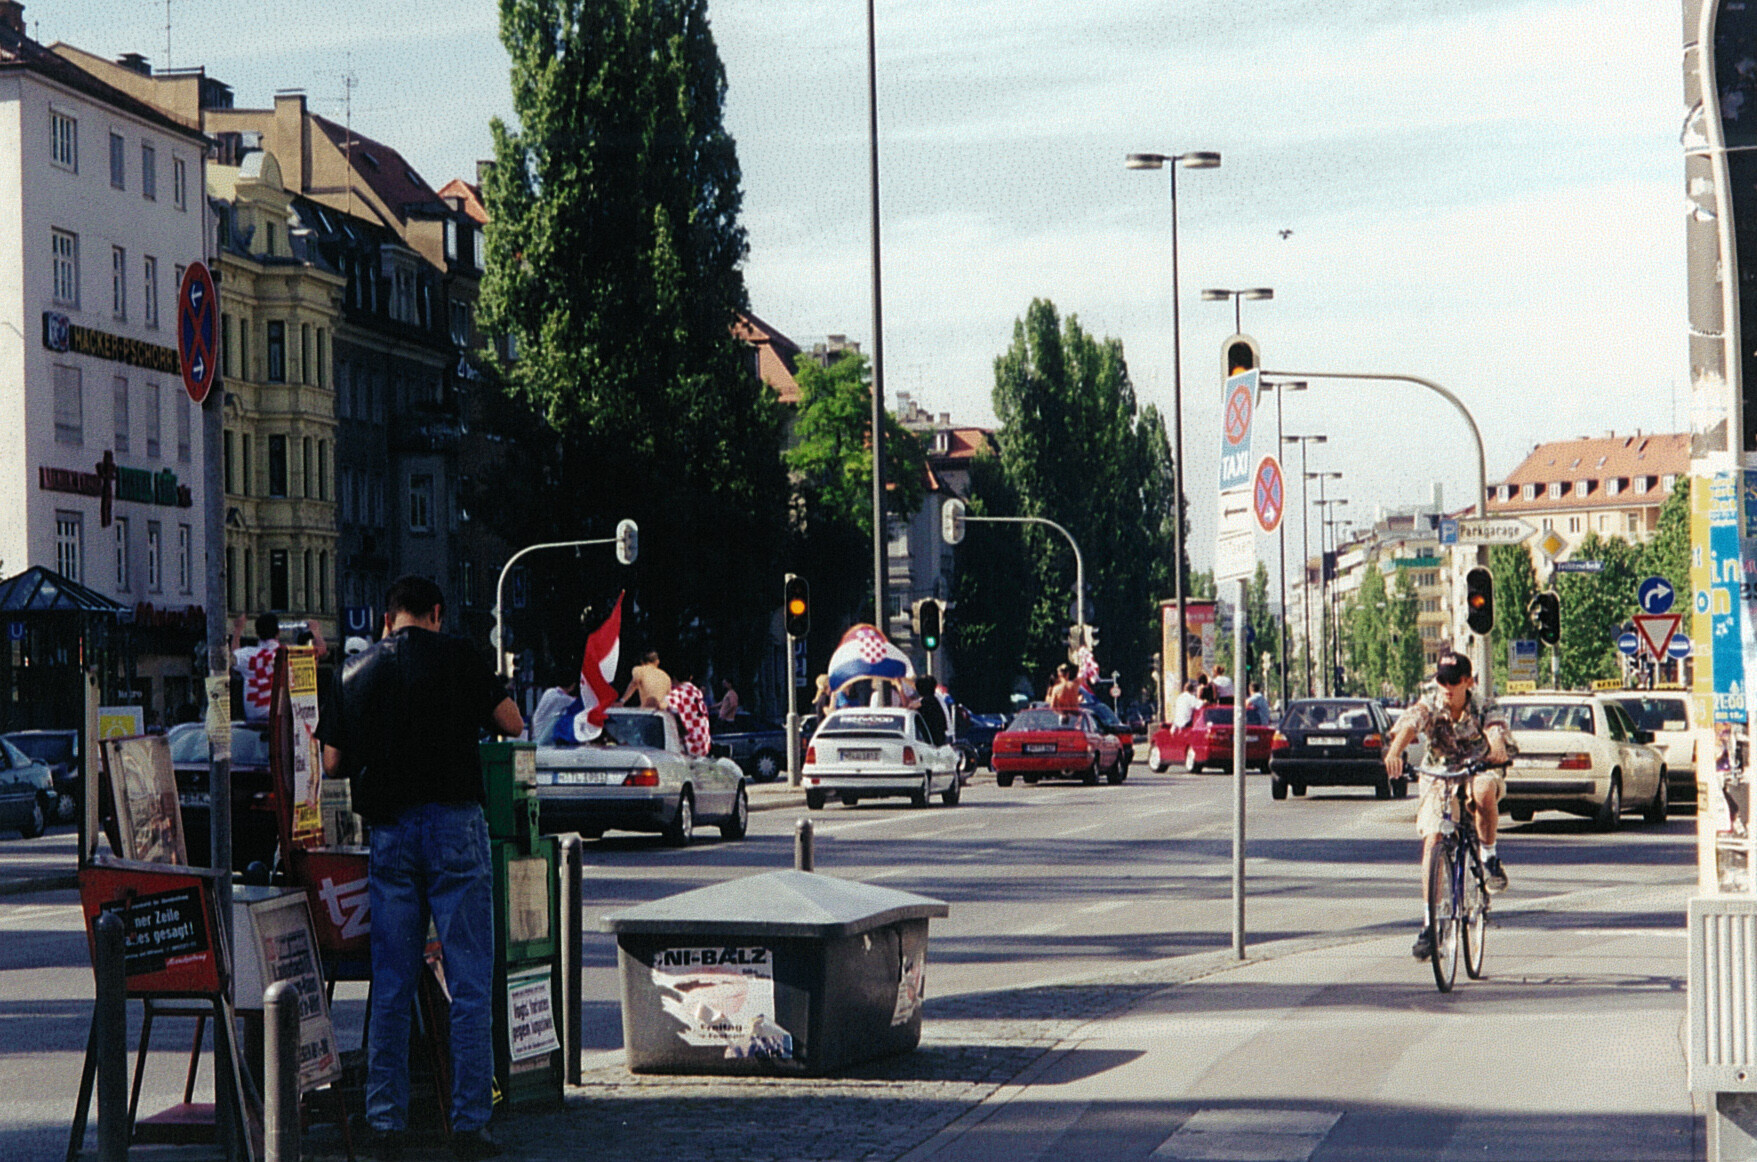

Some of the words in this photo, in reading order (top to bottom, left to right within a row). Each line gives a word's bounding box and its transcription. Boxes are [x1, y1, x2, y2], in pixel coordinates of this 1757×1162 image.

[74, 325, 174, 372] HACKER-PSCHORR
[1222, 453, 1249, 481] TAXI
[1460, 523, 1520, 539] Parkgarage
[349, 609, 366, 629] U
[155, 908, 181, 924] Zeile
[319, 876, 370, 940] tz
[153, 921, 195, 945] gesagt!
